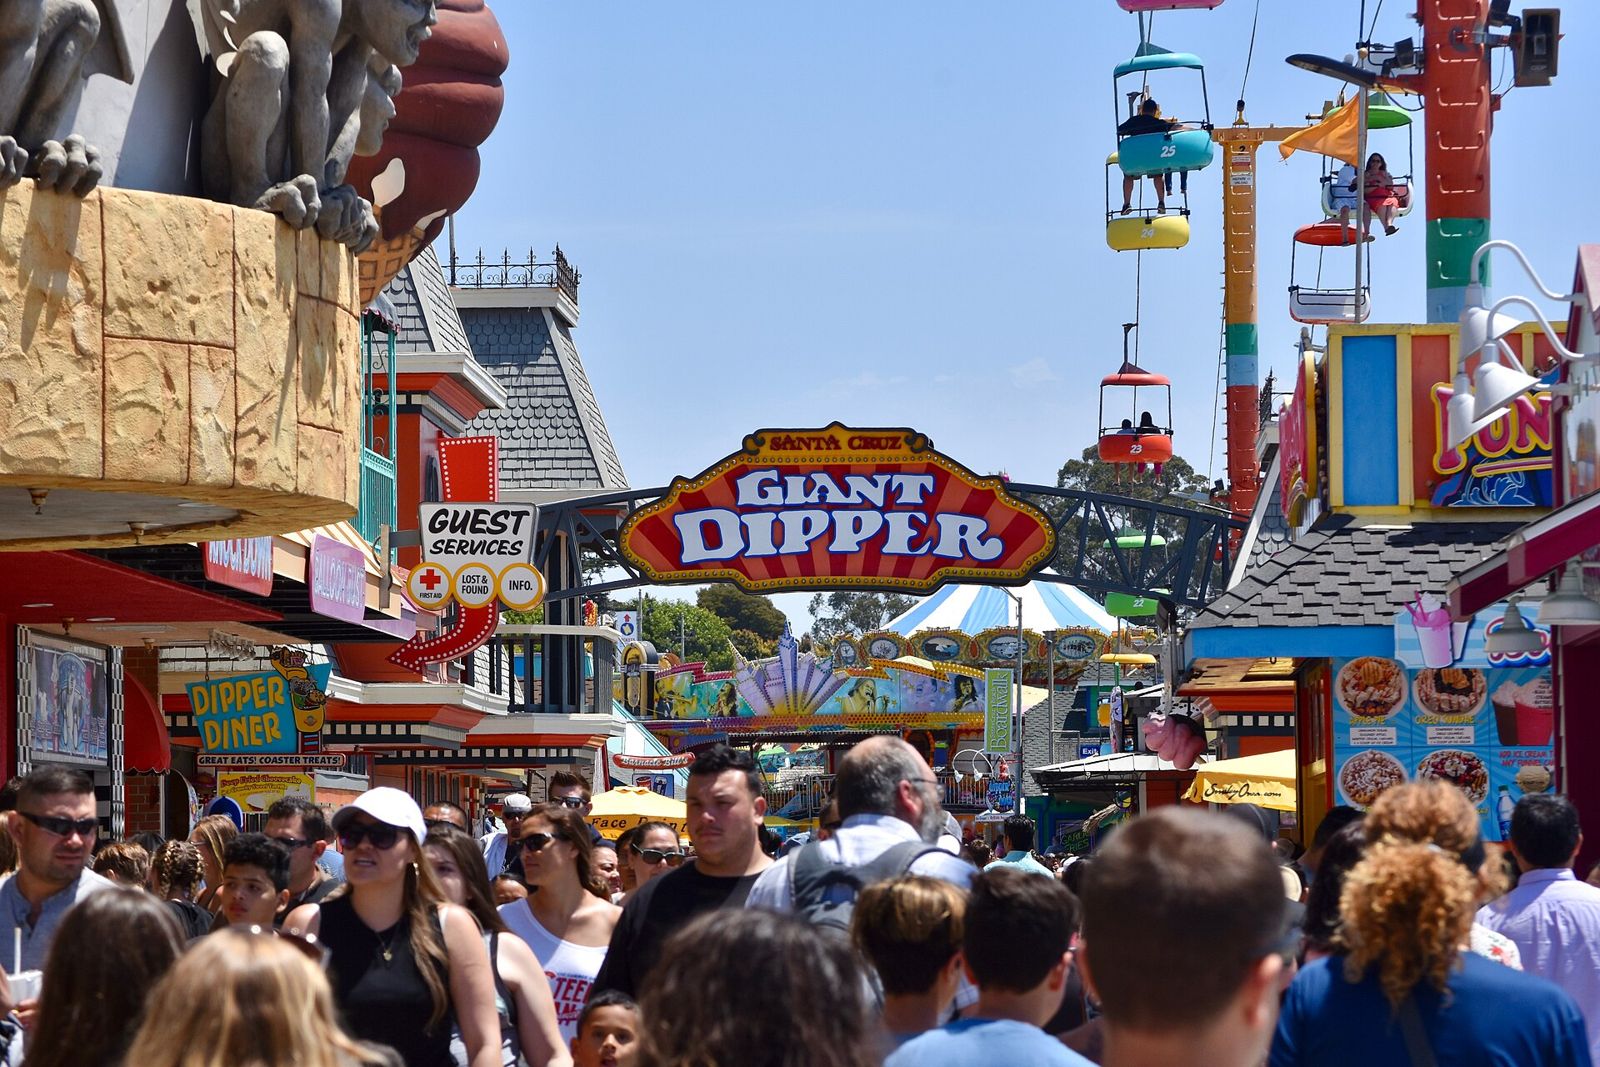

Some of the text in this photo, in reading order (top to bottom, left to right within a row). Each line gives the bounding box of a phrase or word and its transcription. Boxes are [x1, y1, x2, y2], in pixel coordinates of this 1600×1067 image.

[1161, 145, 1176, 158] 25
[1141, 229, 1154, 238] 24
[769, 434, 903, 452] SANTA CRUZ
[1130, 444, 1143, 455] 23
[736, 469, 935, 507] GIANT
[428, 508, 530, 536] GUEST
[673, 508, 1004, 566] DIPPER
[429, 538, 524, 557] SERVICES
[461, 574, 488, 584] LOST &
[461, 585, 489, 595] FOUND
[508, 580, 533, 591] INFO.
[1133, 599, 1144, 608] 22
[191, 676, 284, 716] DIPPER
[990, 672, 1009, 750] Boardwalk
[204, 711, 282, 750] DINER
[1083, 746, 1099, 756] Exit
[199, 756, 341, 765] GREAT EATS! COASTER TREATS!
[592, 817, 627, 829] Face
